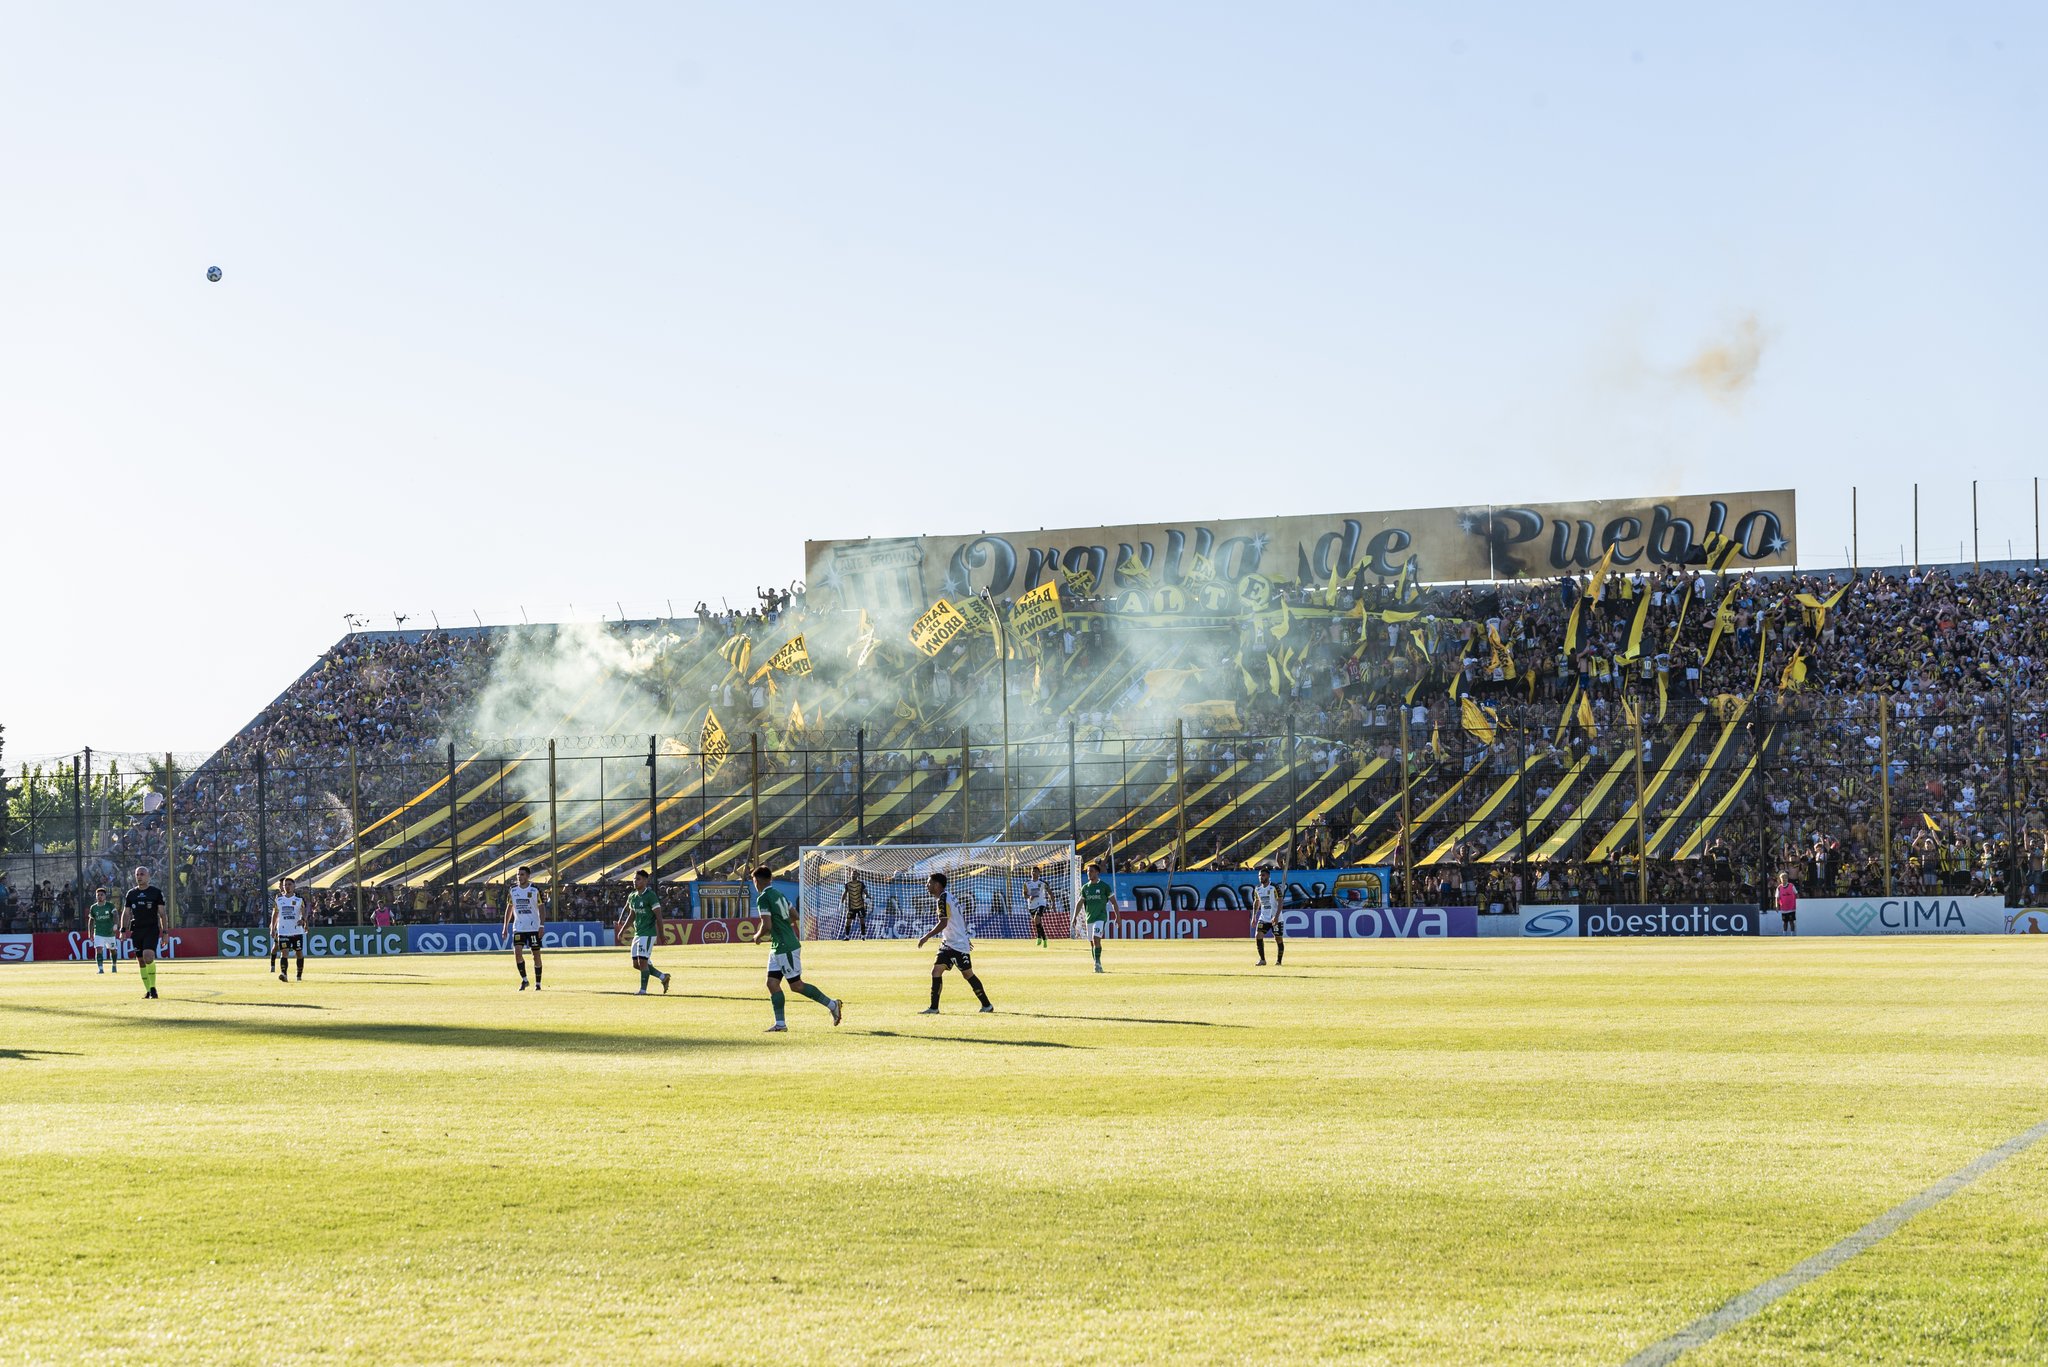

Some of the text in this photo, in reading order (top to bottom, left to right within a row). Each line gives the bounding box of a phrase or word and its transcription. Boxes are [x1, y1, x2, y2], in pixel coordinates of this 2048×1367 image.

[1313, 519, 1411, 579] de
[1457, 500, 1783, 577] Pueblo
[870, 549, 916, 567] BROWN
[1104, 911, 1208, 939] hneider
[1587, 906, 1748, 936] pbestatica
[1879, 900, 1966, 928] CIMA
[222, 928, 402, 957] Sislectric
[455, 925, 597, 951] novech
[620, 922, 693, 945] esy
[704, 931, 728, 942] easy
